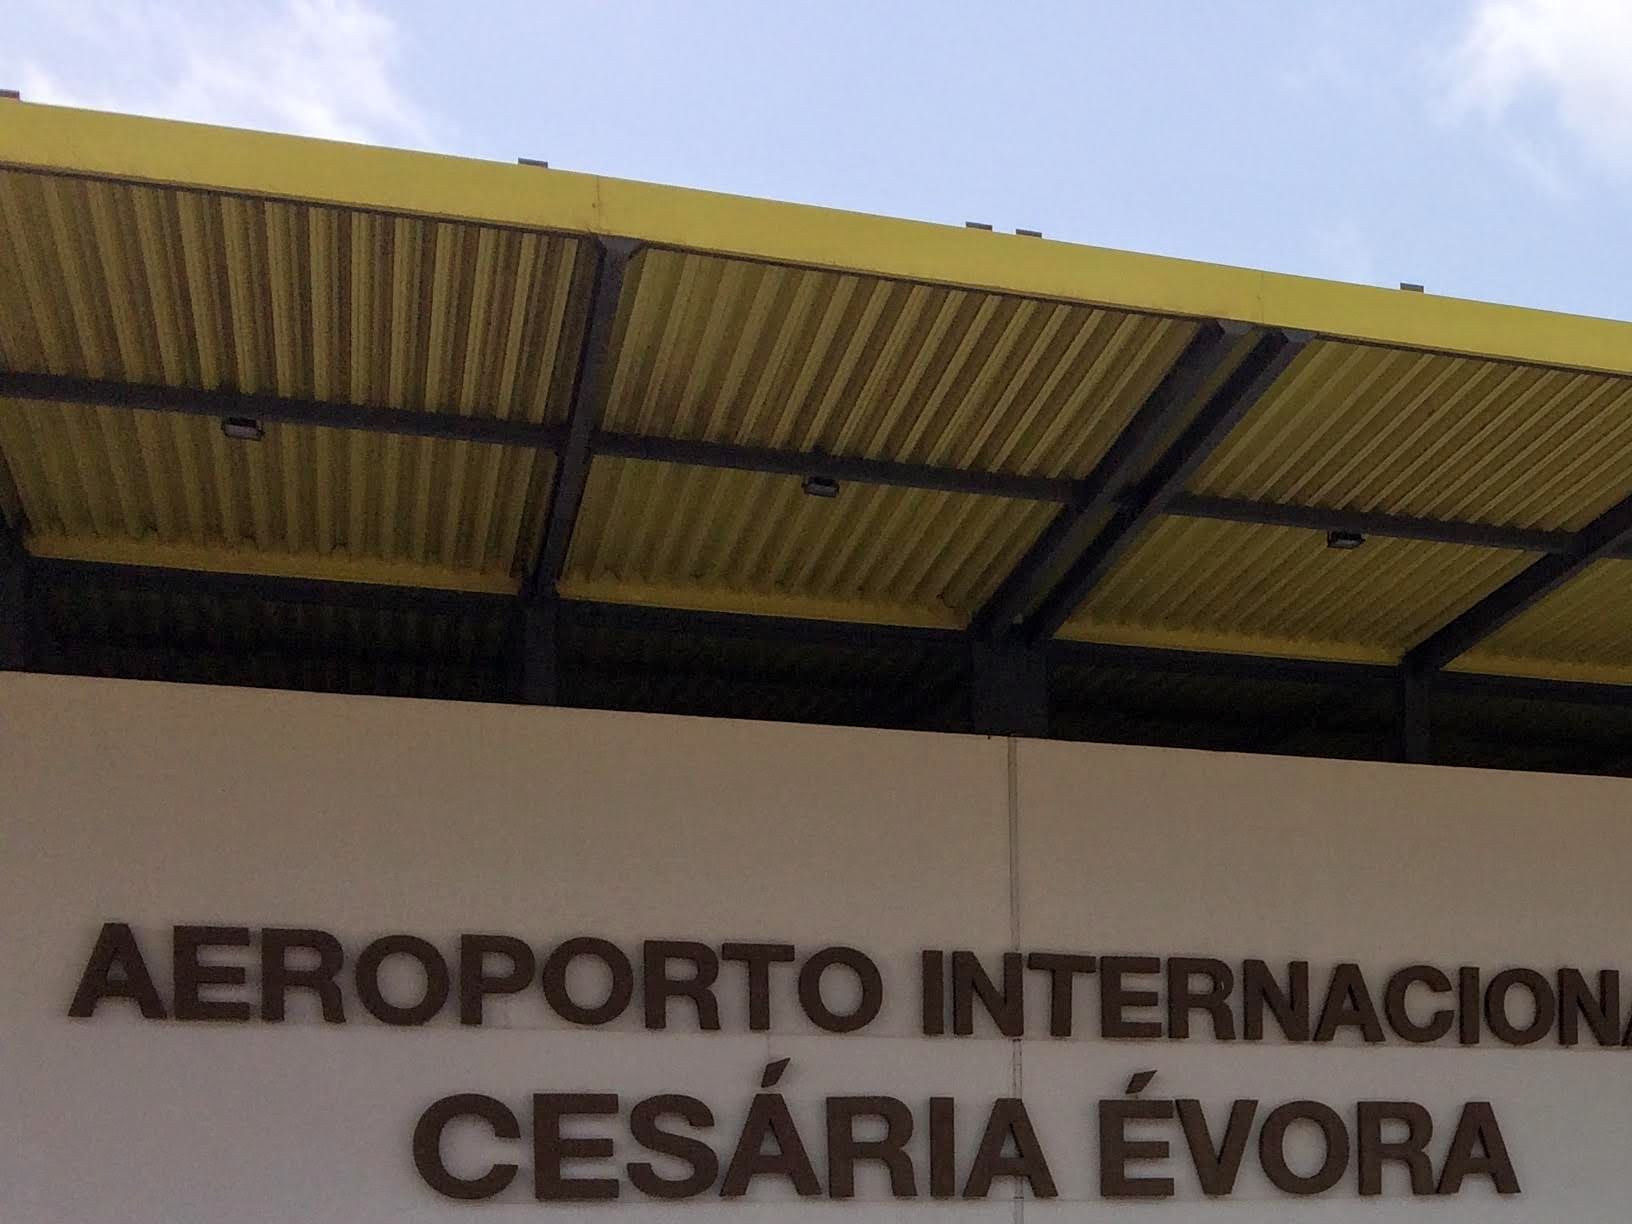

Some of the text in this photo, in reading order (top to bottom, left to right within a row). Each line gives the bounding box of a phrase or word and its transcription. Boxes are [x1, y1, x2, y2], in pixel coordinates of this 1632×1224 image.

[67, 922, 883, 1032] AEROPORTO
[412, 1057, 1522, 1200] CESÁRIA ÉVORA
